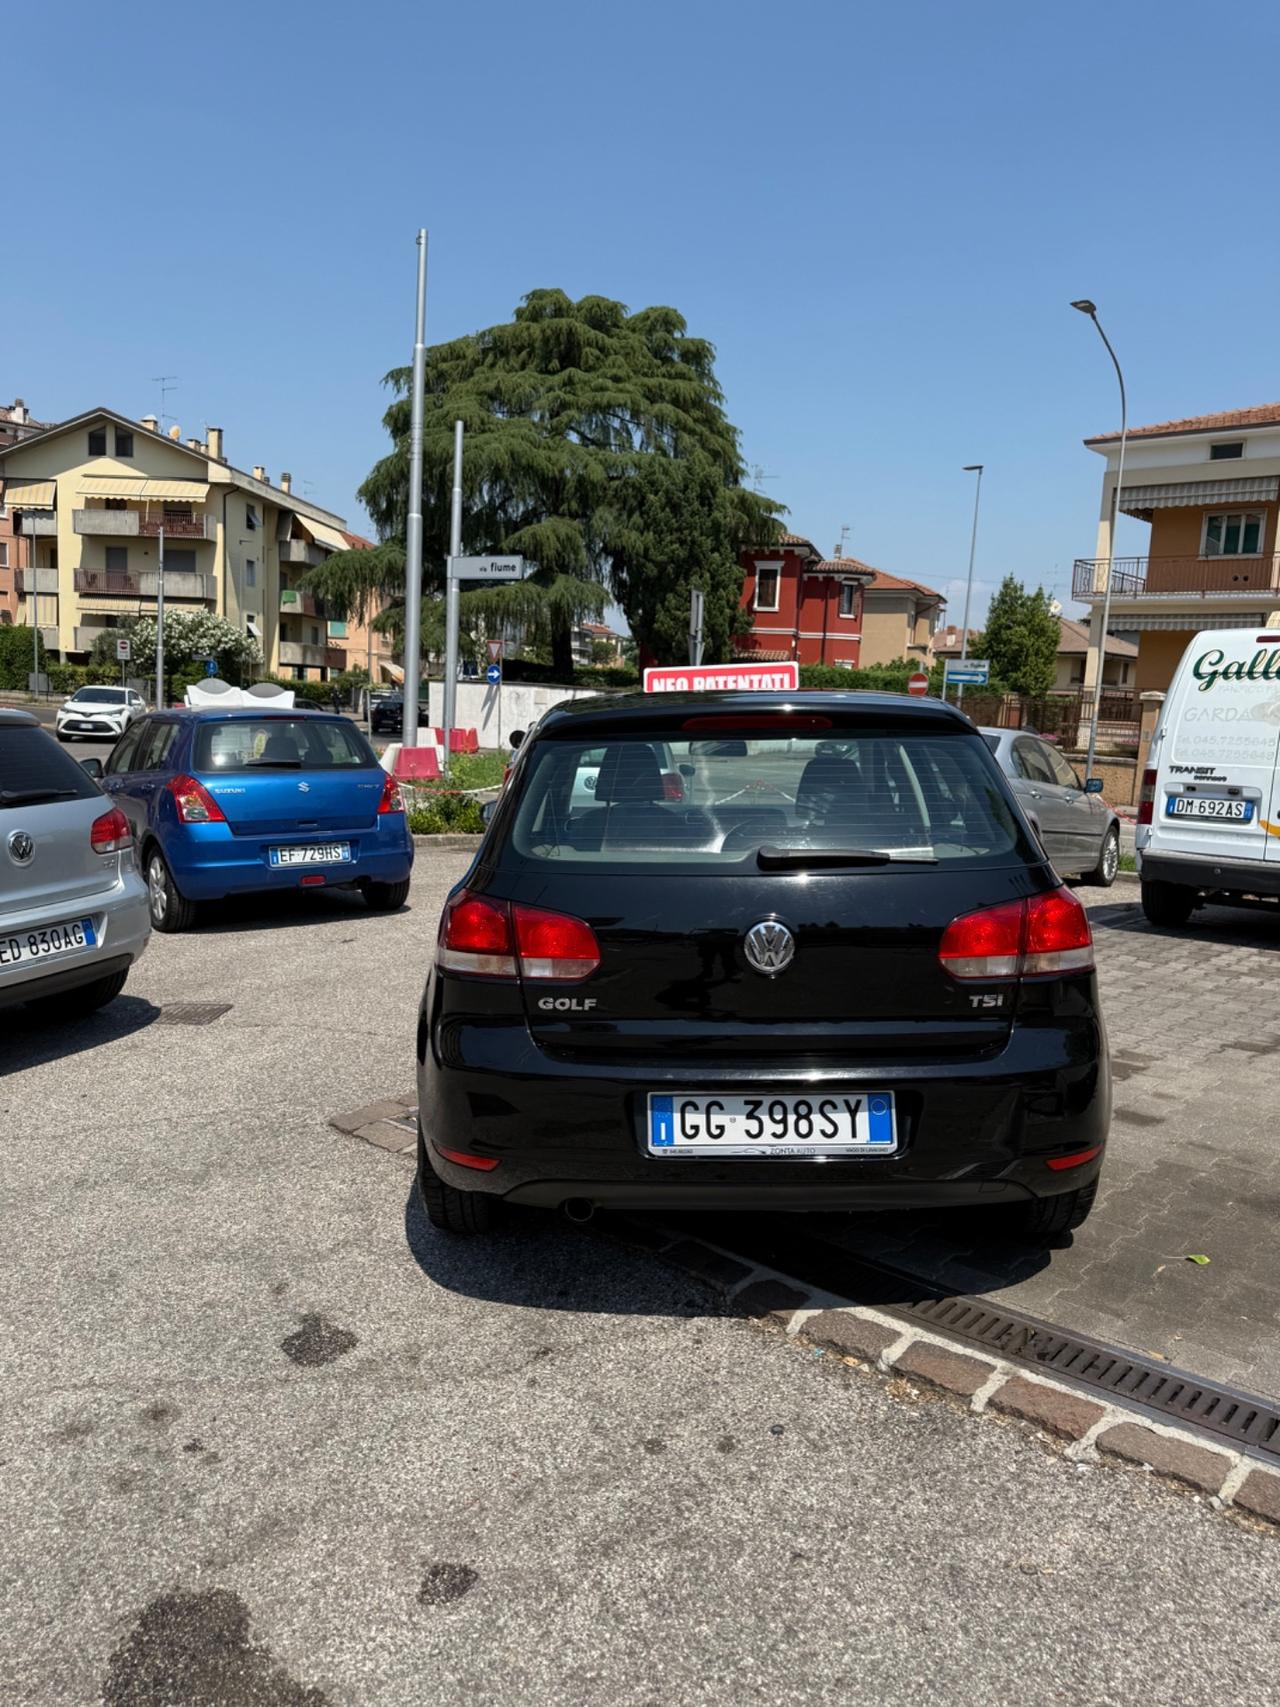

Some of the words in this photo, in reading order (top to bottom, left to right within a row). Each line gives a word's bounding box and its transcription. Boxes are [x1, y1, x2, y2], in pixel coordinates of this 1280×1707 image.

[491, 562, 516, 572] fiume
[1169, 765, 1216, 775] TRANSIT
[1177, 799, 1194, 813] DM
[1198, 801, 1244, 817] 692AS
[280, 848, 296, 862] EF
[301, 846, 341, 861] 729HS
[0, 938, 22, 963] ED
[28, 923, 84, 957] 830AG
[538, 997, 598, 1010] GOLF
[680, 1100, 726, 1140] GG
[743, 1099, 862, 1140] 398SY
